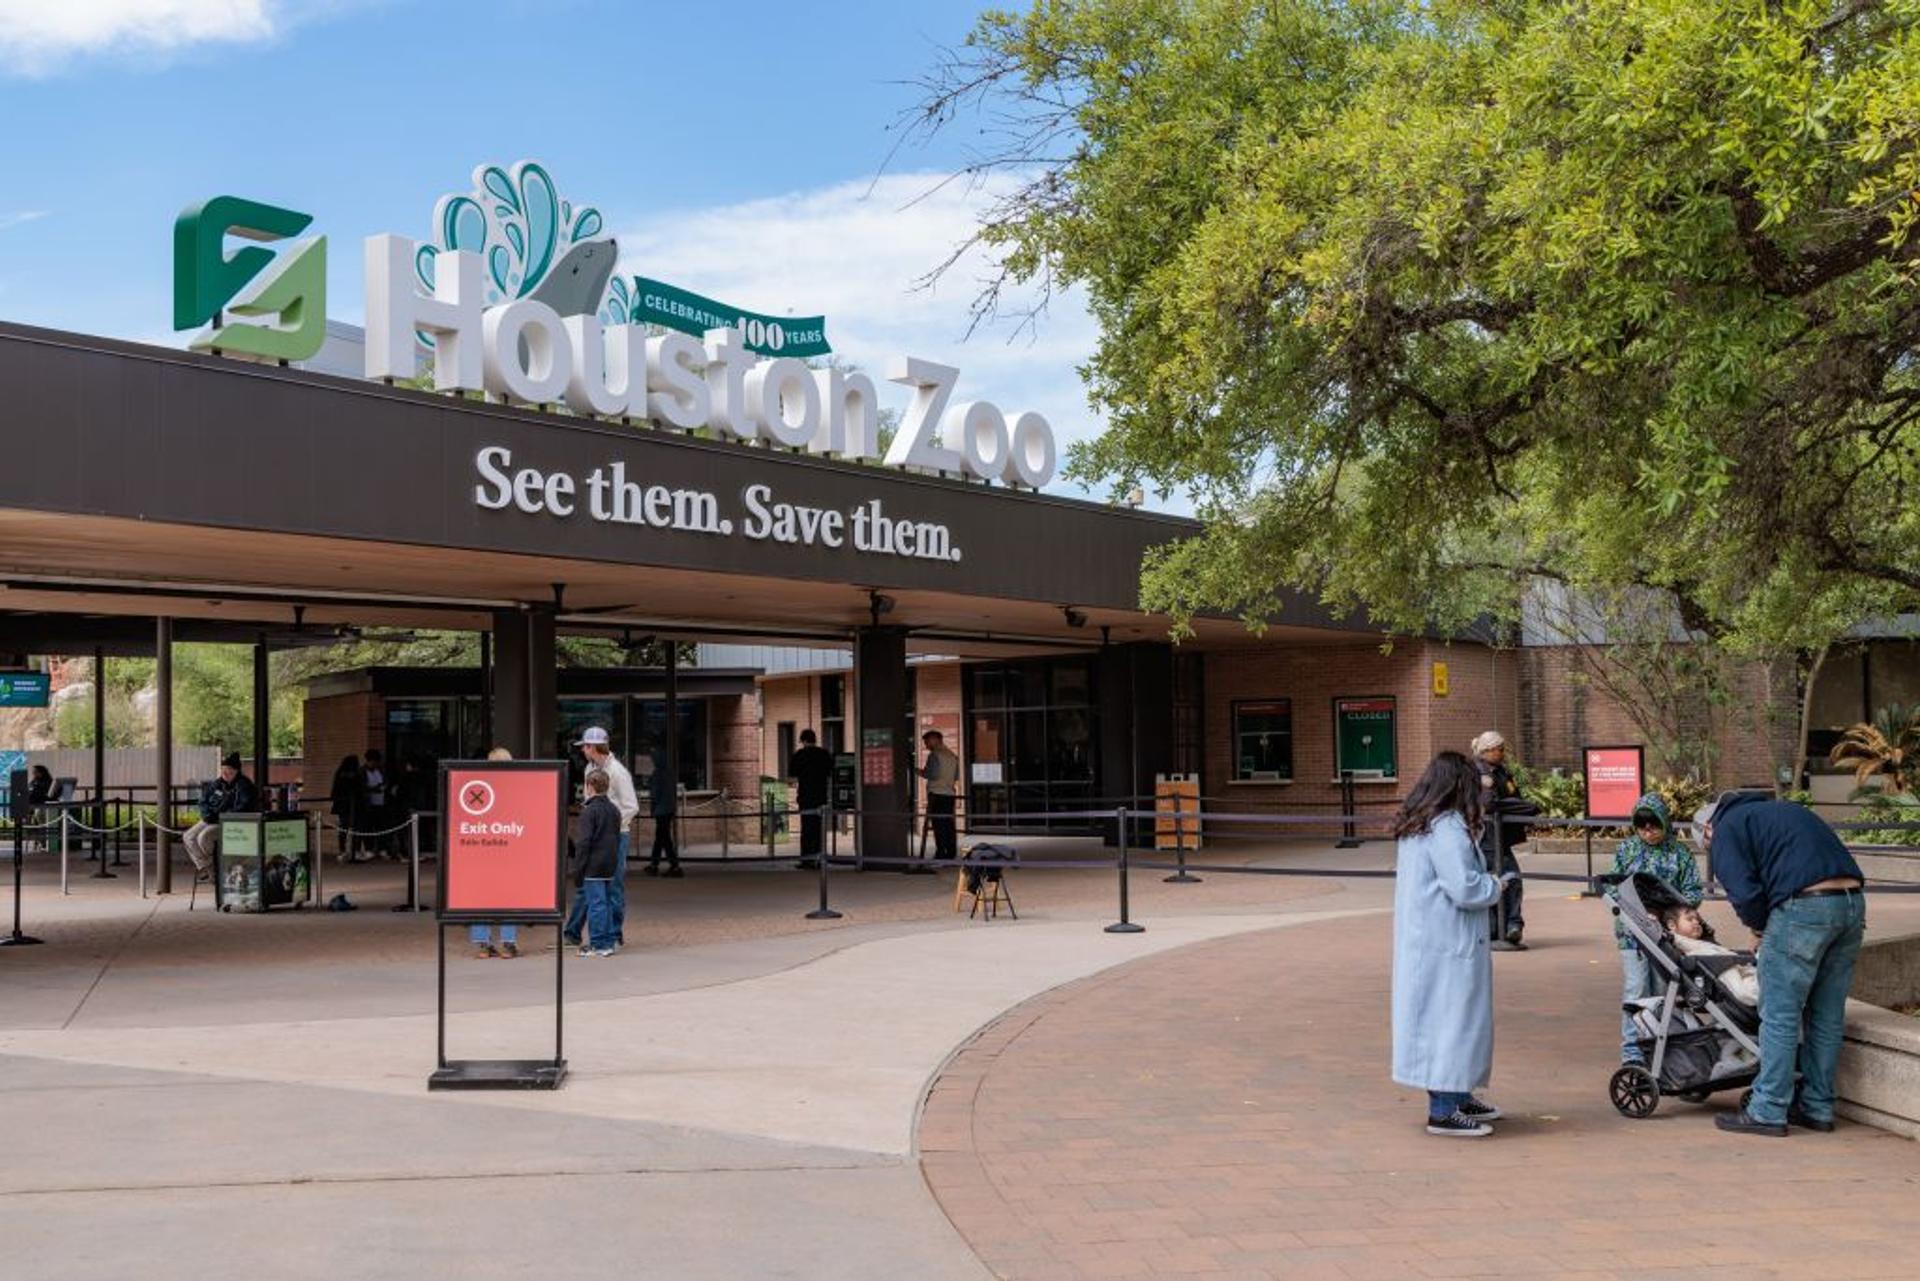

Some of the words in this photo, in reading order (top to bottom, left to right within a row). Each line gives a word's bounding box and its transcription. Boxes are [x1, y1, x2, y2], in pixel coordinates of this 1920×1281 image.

[364, 233, 878, 459] Houston
[884, 356, 1057, 489] Zoo
[735, 316, 784, 350] 100
[784, 331, 822, 345] YEARS
[475, 446, 574, 517] See
[586, 461, 733, 536] them.
[743, 484, 844, 548] Save
[850, 499, 962, 562] them.
[460, 822, 487, 834] Exit
[490, 822, 524, 836] Only
